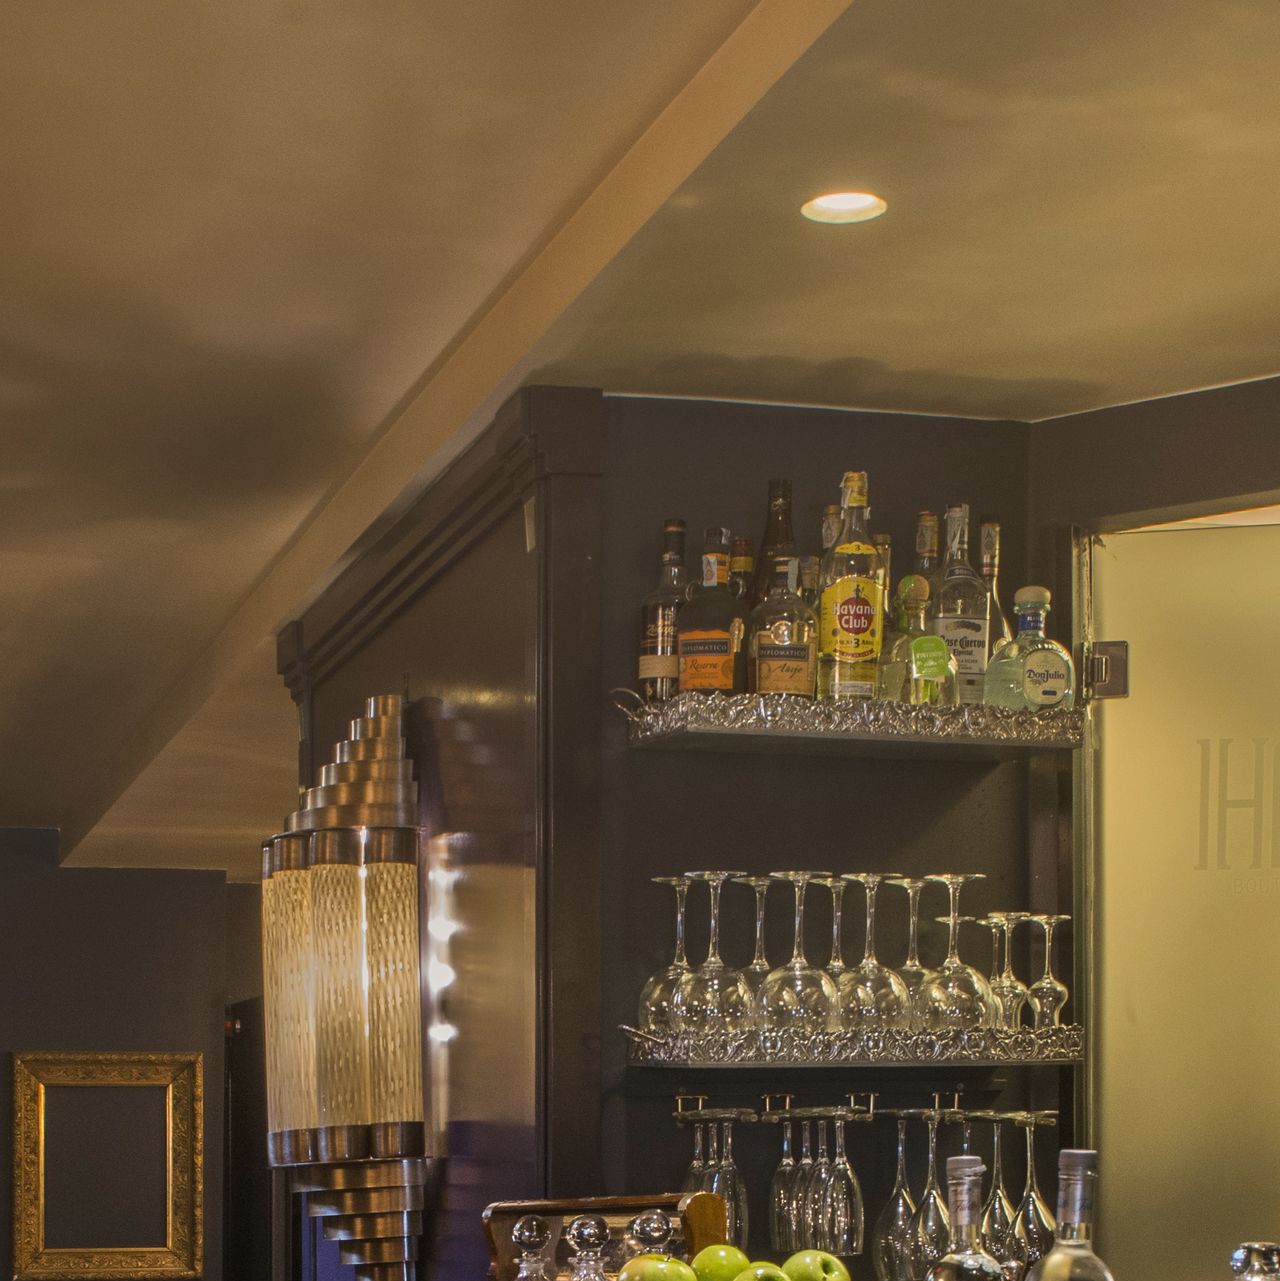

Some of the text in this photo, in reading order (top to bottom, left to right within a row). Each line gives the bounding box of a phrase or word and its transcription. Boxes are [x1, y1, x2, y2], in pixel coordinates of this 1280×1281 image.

[833, 603, 877, 615] Havana
[841, 615, 868, 628] Club
[852, 637, 860, 648] 3
